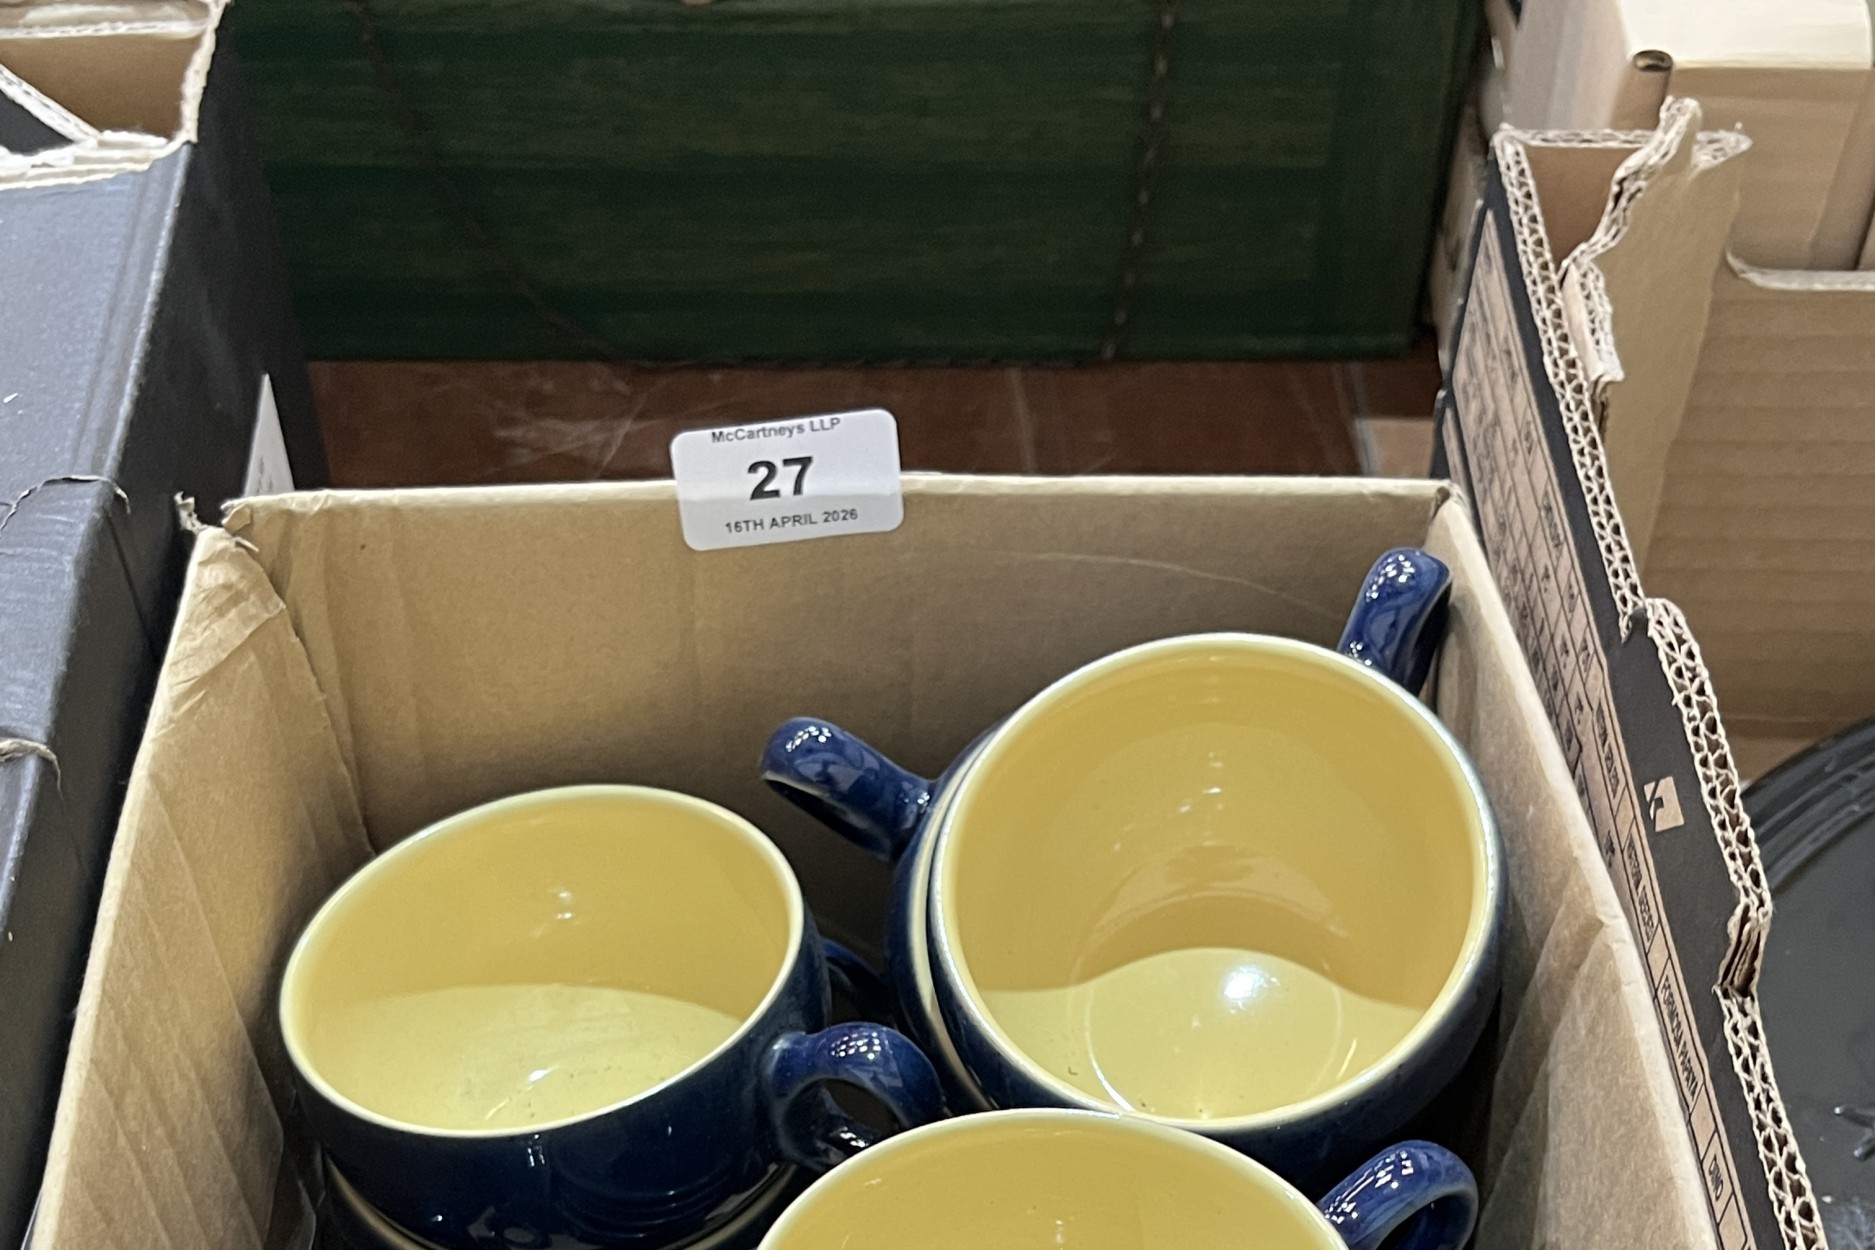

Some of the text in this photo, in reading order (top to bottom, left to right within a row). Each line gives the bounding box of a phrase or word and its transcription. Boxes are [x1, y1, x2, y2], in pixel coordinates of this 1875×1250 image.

[711, 417, 841, 443] McCartneys LLP
[747, 455, 814, 501] 27
[725, 508, 859, 534] 16TH APRIL 2026
